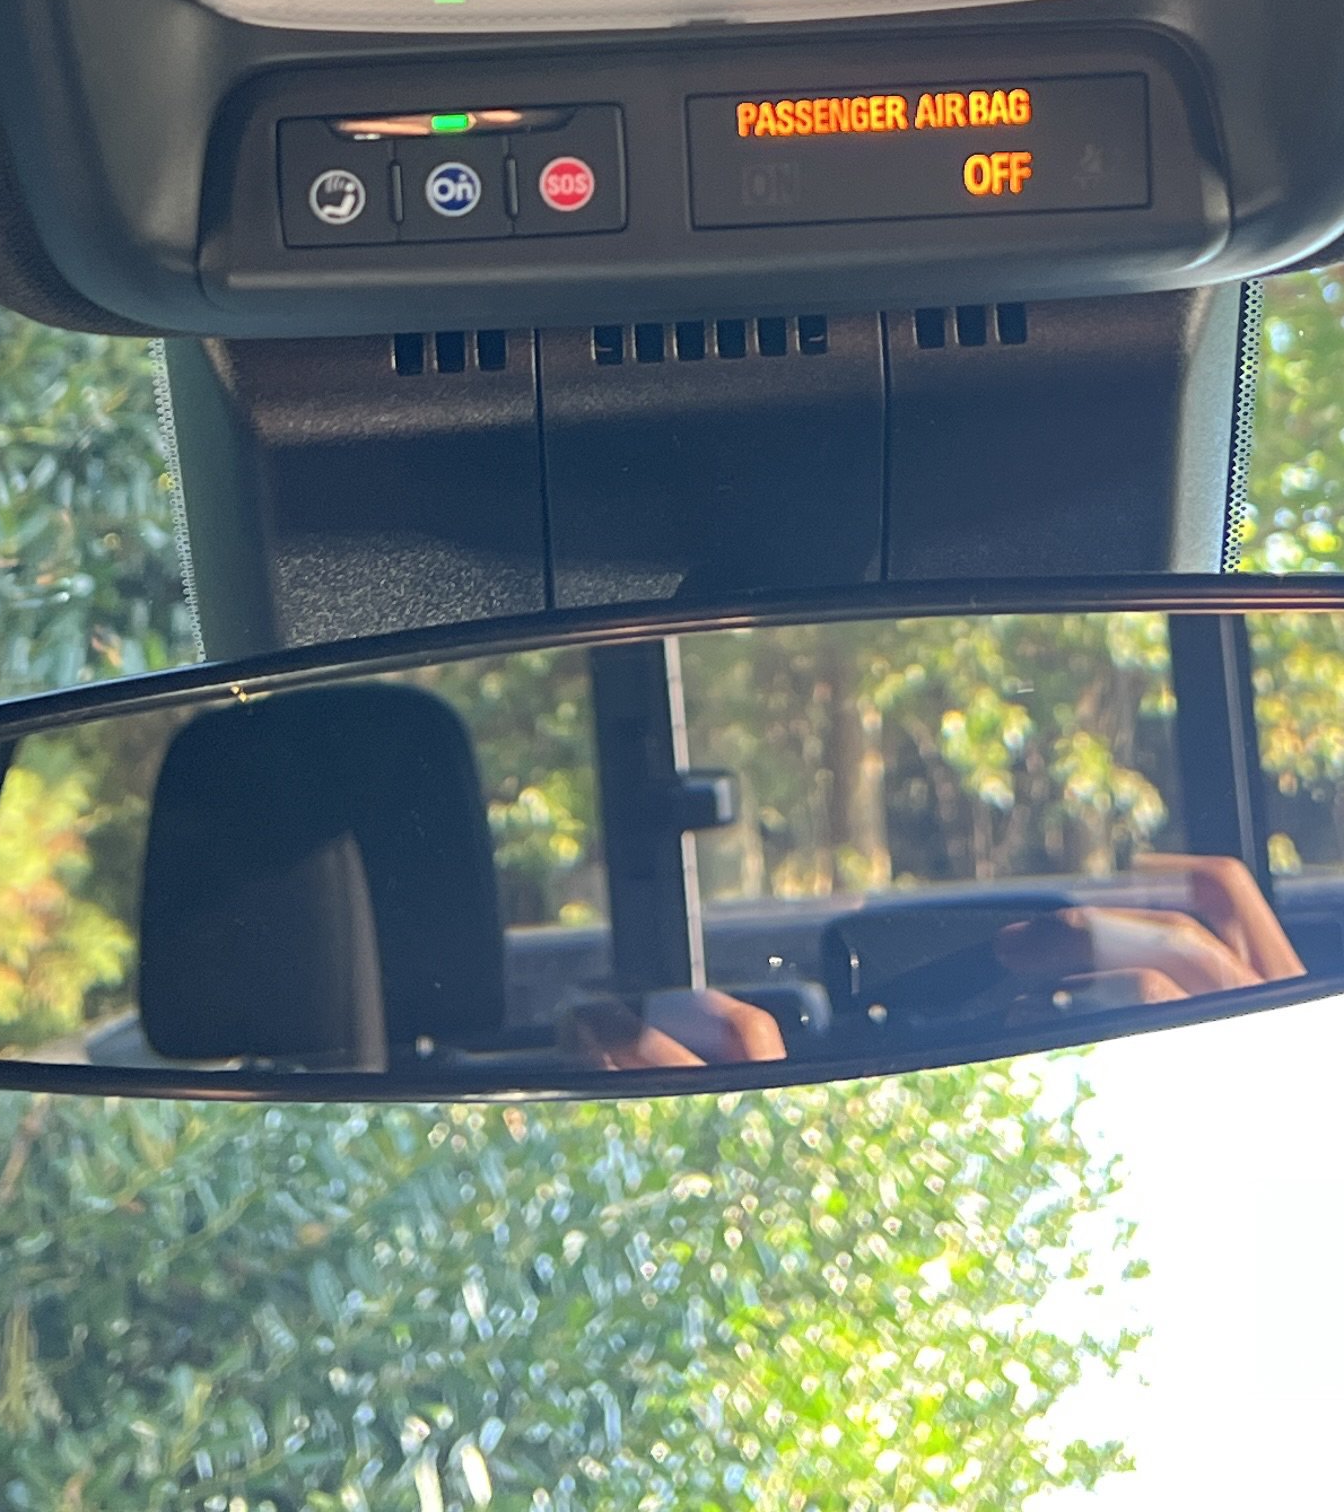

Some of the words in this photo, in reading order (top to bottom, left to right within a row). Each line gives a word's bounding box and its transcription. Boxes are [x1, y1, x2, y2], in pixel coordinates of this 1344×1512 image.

[736, 95, 908, 137] PASSENGER
[914, 93, 967, 129] AIR
[968, 88, 1032, 125] BAG
[547, 173, 589, 196] SOS
[963, 151, 1033, 195] OFF
